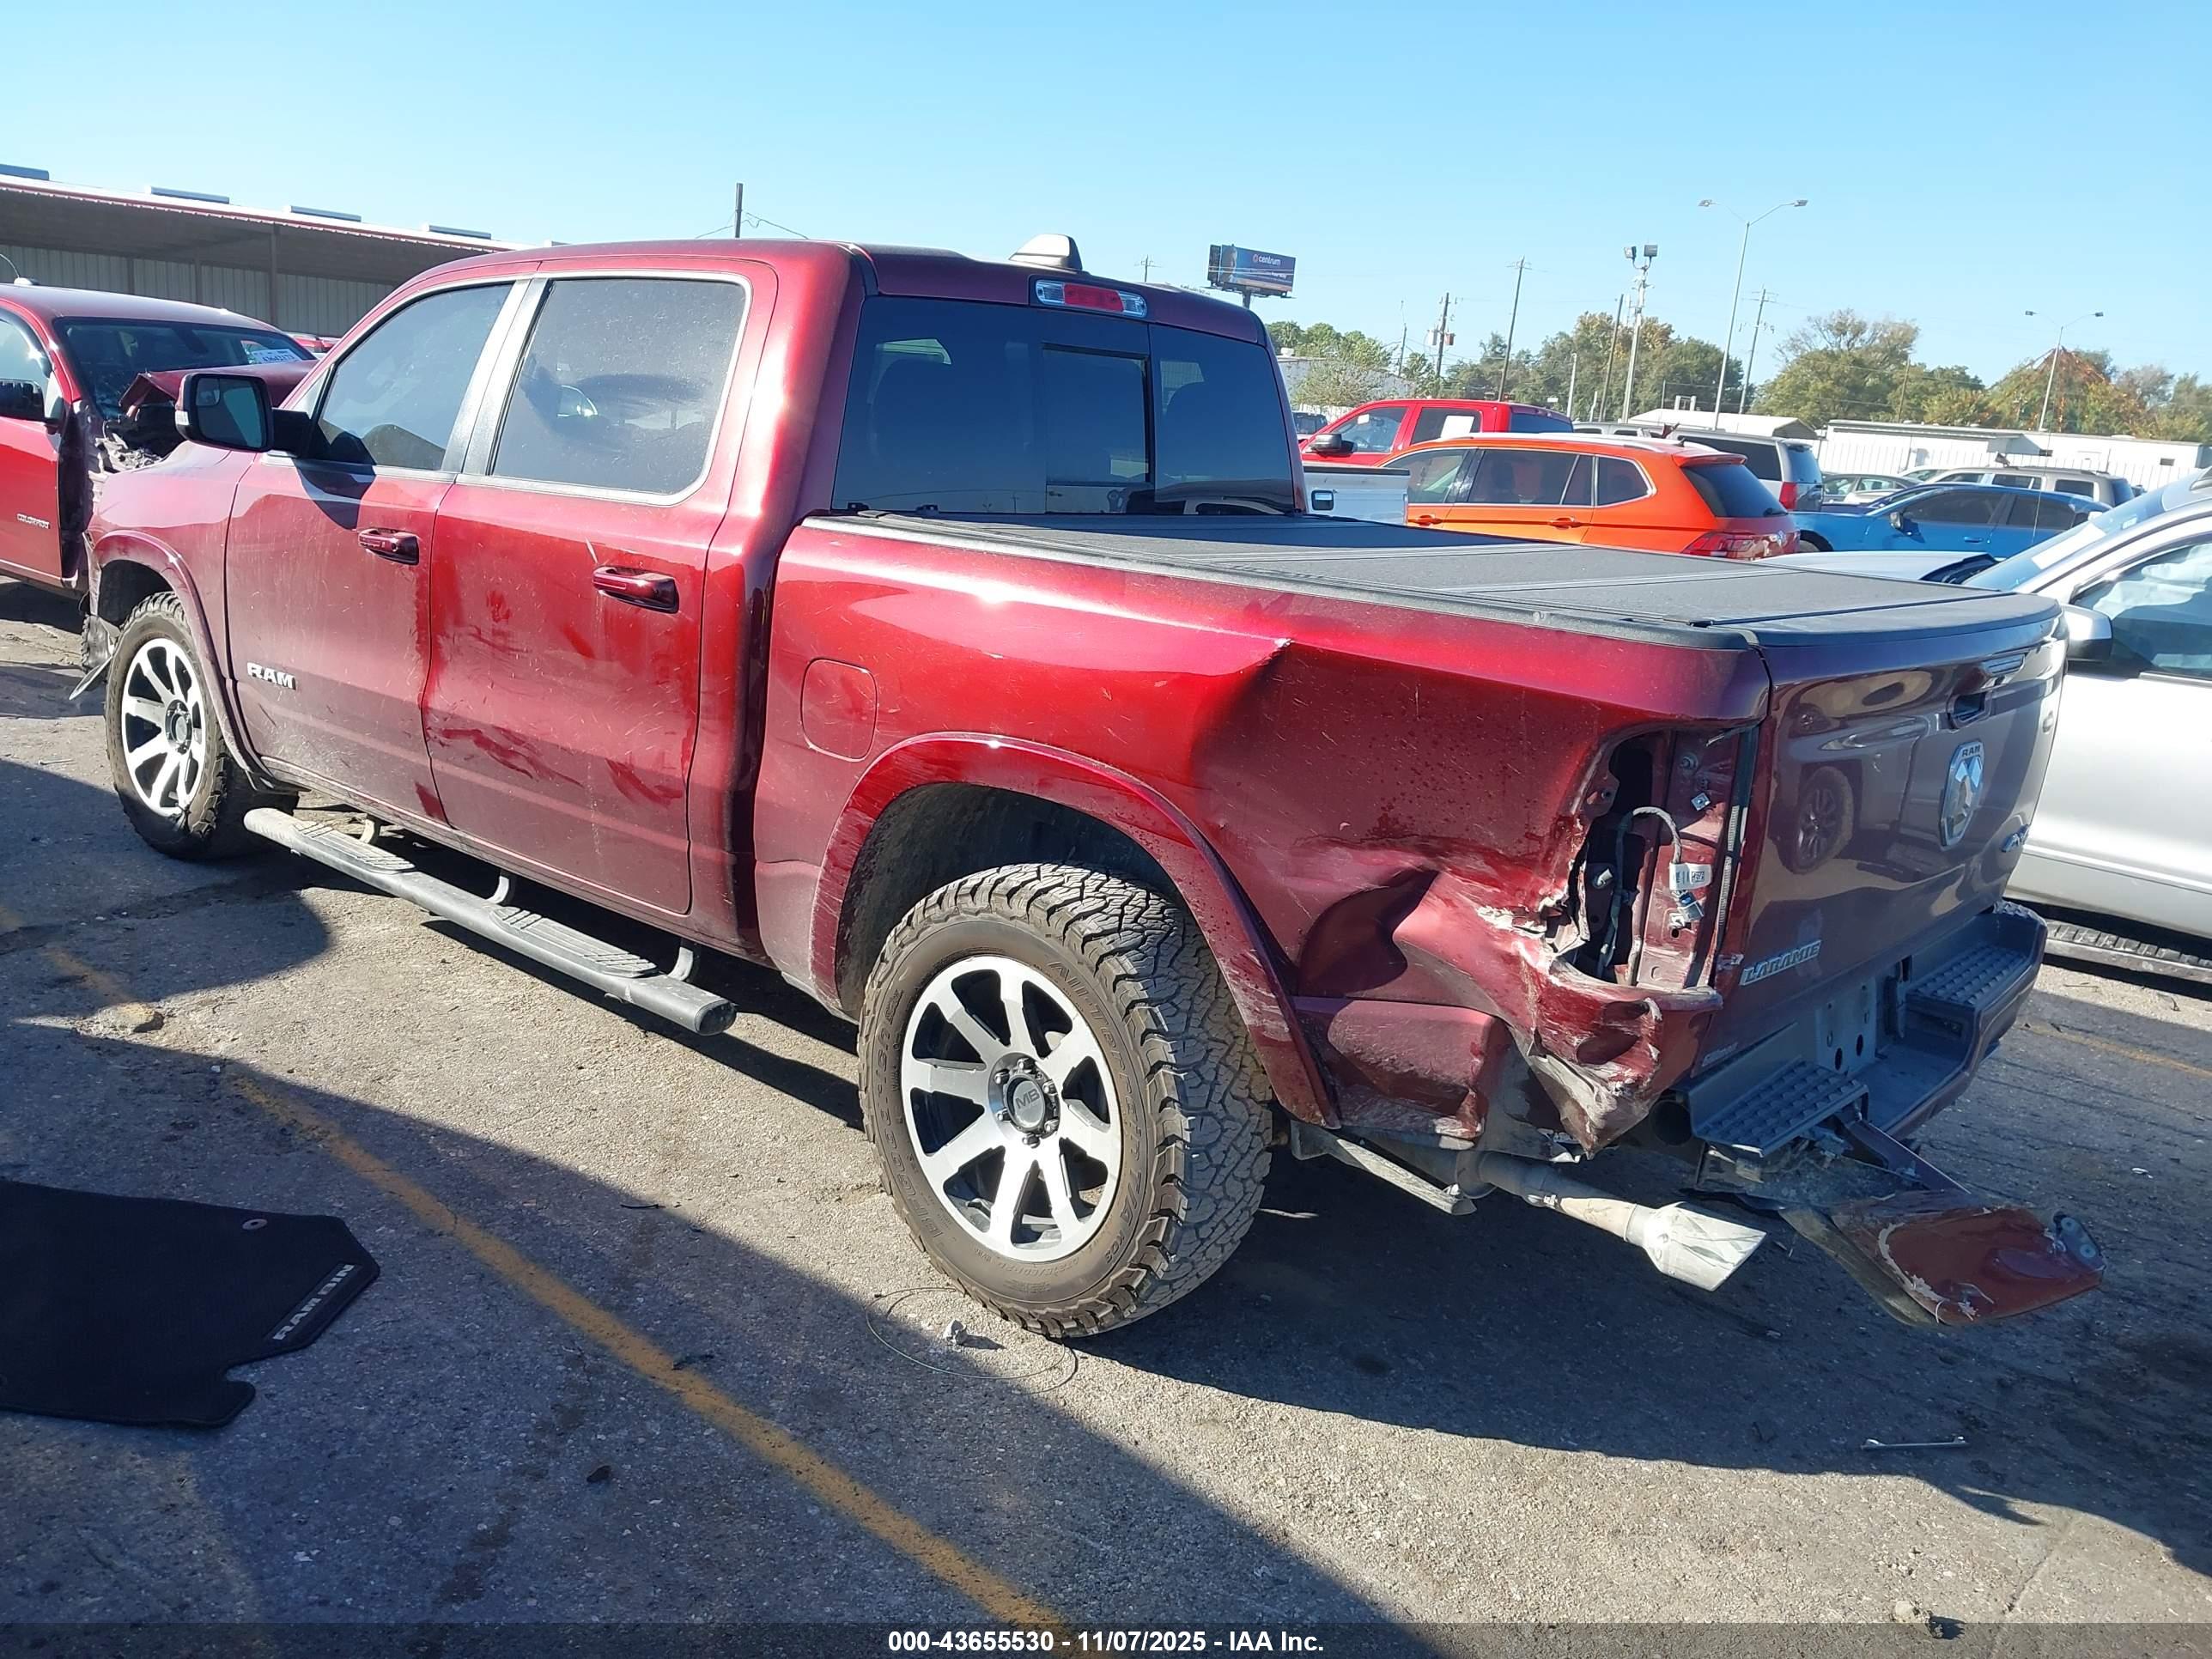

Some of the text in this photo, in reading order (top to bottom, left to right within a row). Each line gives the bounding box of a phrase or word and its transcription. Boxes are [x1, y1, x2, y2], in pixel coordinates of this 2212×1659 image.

[1258, 255, 1281, 265] centrum
[246, 661, 296, 690] RAM
[1961, 744, 1981, 757] RAM
[1739, 939, 1822, 987] LARAMIE
[1015, 1088, 1041, 1109] MB
[272, 1297, 323, 1340] RAM
